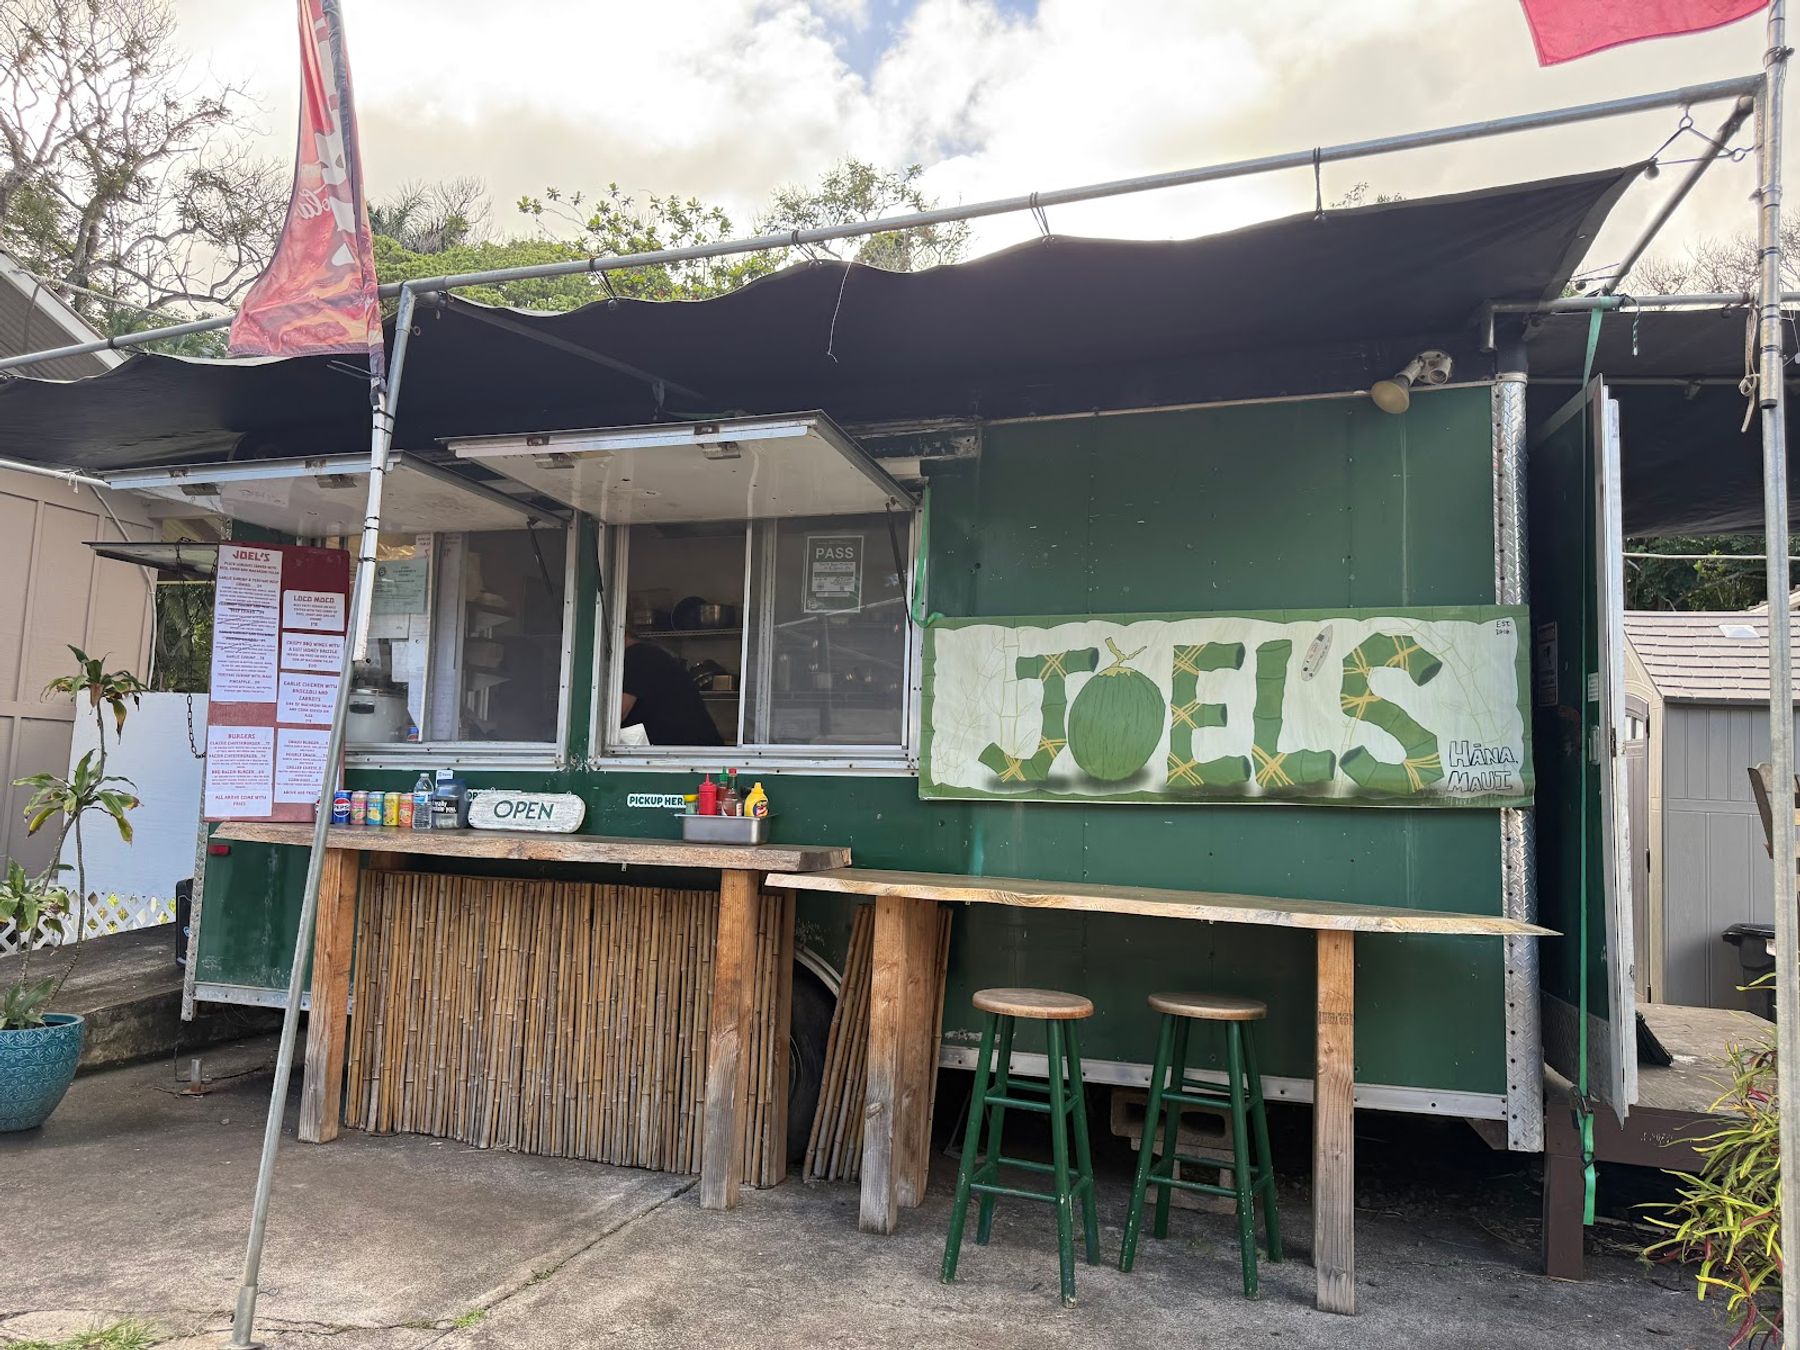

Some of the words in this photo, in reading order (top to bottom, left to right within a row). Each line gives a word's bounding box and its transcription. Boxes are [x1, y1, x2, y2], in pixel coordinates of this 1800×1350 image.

[232, 550, 270, 562] JOEL'S
[816, 547, 854, 559] PASS
[314, 596, 335, 604] MOCO
[1447, 770, 1513, 792] MAUI
[629, 796, 663, 805] PICKUP
[665, 797, 684, 806] HER
[494, 800, 554, 820] OPEN
